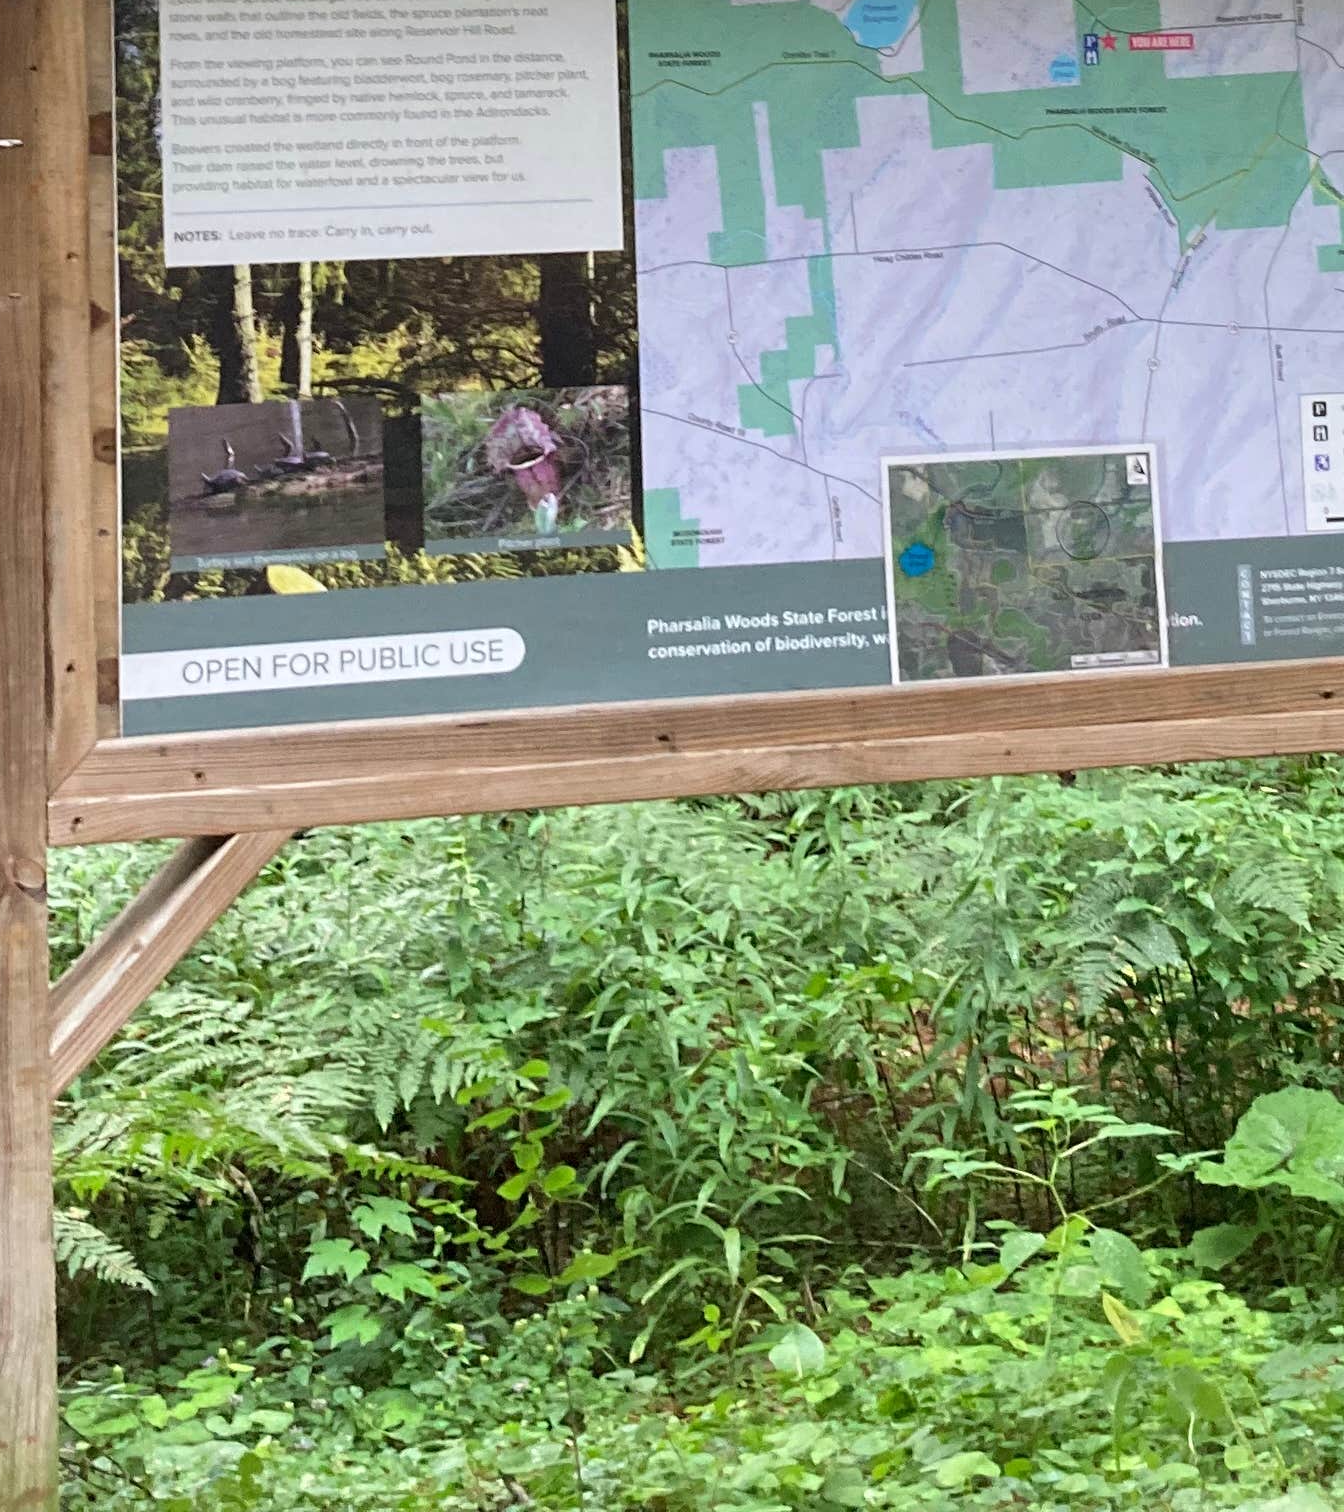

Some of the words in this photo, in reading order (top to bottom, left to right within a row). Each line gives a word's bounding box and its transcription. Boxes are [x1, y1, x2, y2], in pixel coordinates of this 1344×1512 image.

[1133, 37, 1150, 48] YOU
[1151, 36, 1169, 48] ARE
[1169, 36, 1190, 47] HERE
[173, 231, 222, 242] NOTES:
[229, 230, 265, 240] Leave
[269, 229, 285, 239] no
[325, 226, 357, 238] Carry
[360, 225, 374, 237] in,
[378, 225, 406, 236] carry
[1309, 595, 1322, 603] NY
[647, 617, 721, 634] Pharsalia
[725, 614, 779, 630] Woods
[783, 611, 824, 626] State
[828, 607, 878, 623] Forest
[648, 639, 751, 659] conservation
[755, 637, 771, 652] of
[775, 633, 870, 652] biodiversity,
[182, 658, 261, 684] OPEN
[273, 653, 329, 677] FOR
[340, 644, 440, 673] PUBLIC
[449, 639, 504, 665] USE
